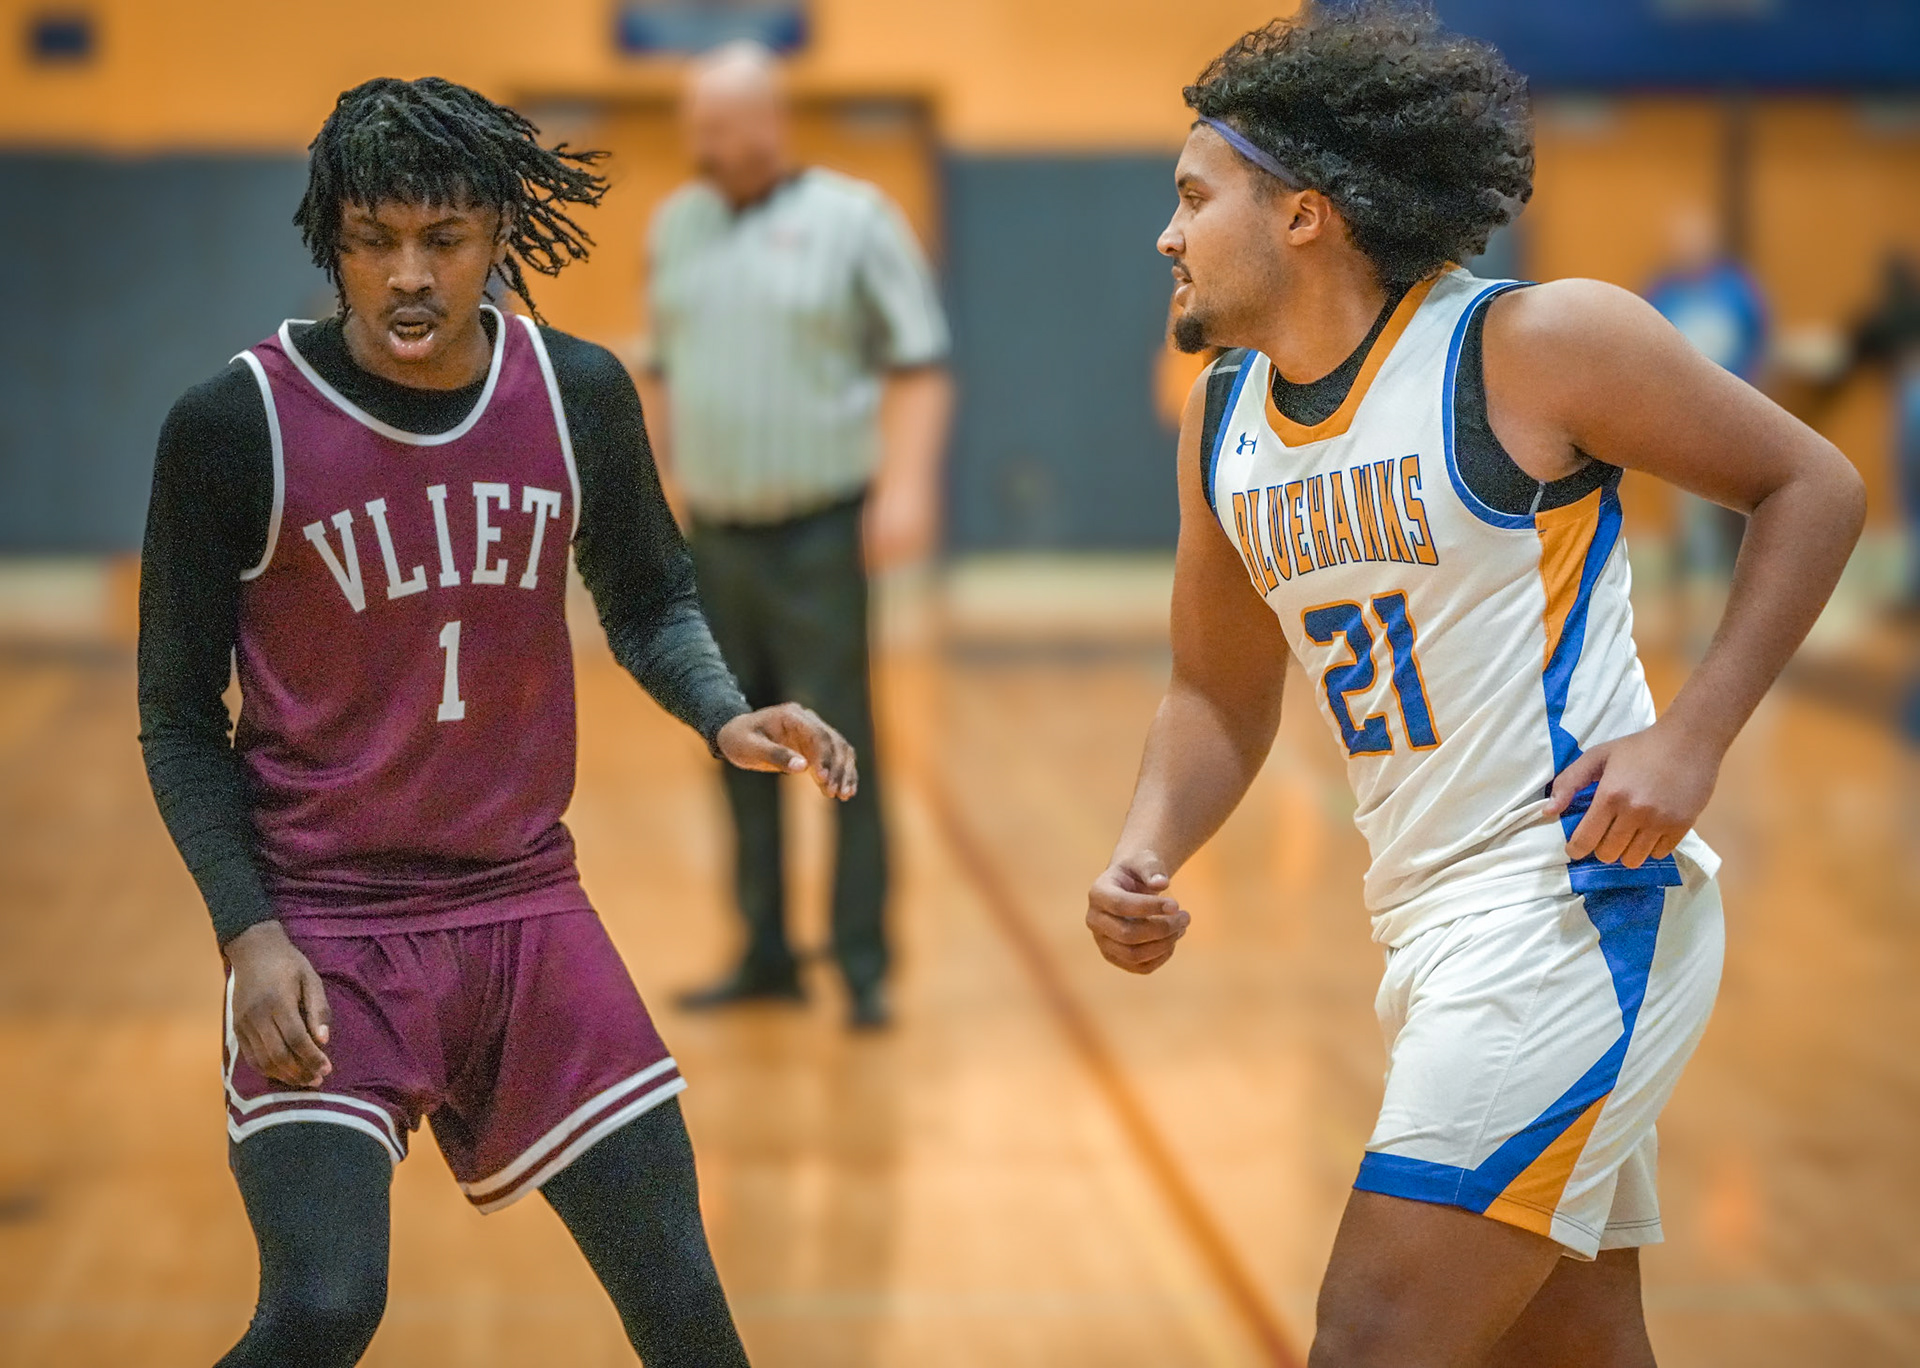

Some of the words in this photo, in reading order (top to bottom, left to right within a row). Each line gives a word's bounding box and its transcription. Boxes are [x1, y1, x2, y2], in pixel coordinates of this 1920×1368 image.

[303, 482, 561, 612] VLIET
[1232, 454, 1439, 598] BLUEHAWKS
[437, 621, 465, 722] 1
[1301, 589, 1442, 759] 21
